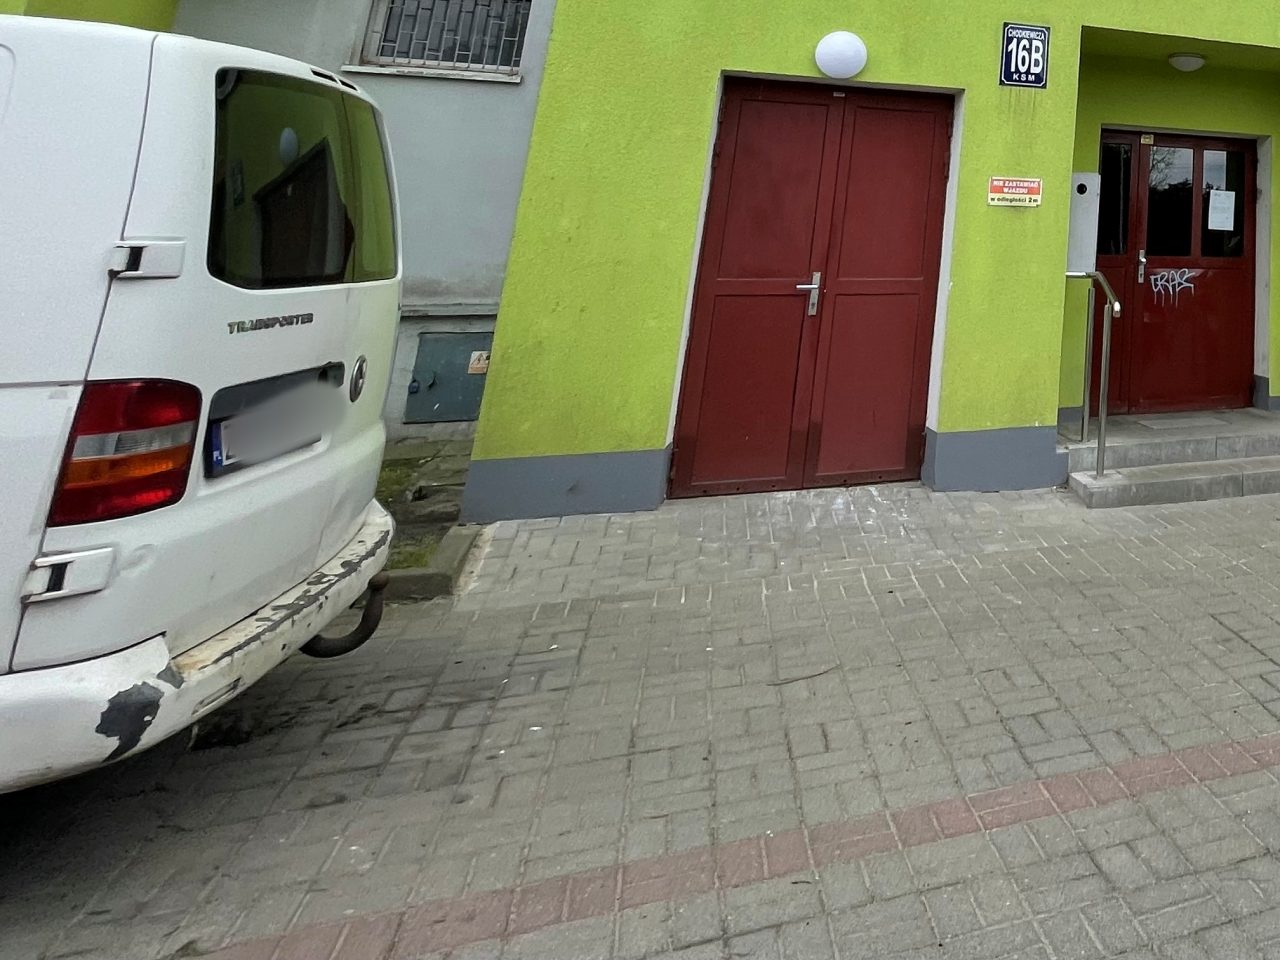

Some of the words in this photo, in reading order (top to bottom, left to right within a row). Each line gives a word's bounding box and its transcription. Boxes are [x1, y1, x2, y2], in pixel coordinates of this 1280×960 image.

[1008, 28, 1045, 41] CHODKIEWICZA
[1008, 37, 1044, 74] 16B
[227, 312, 314, 335] TRANSPORTER
